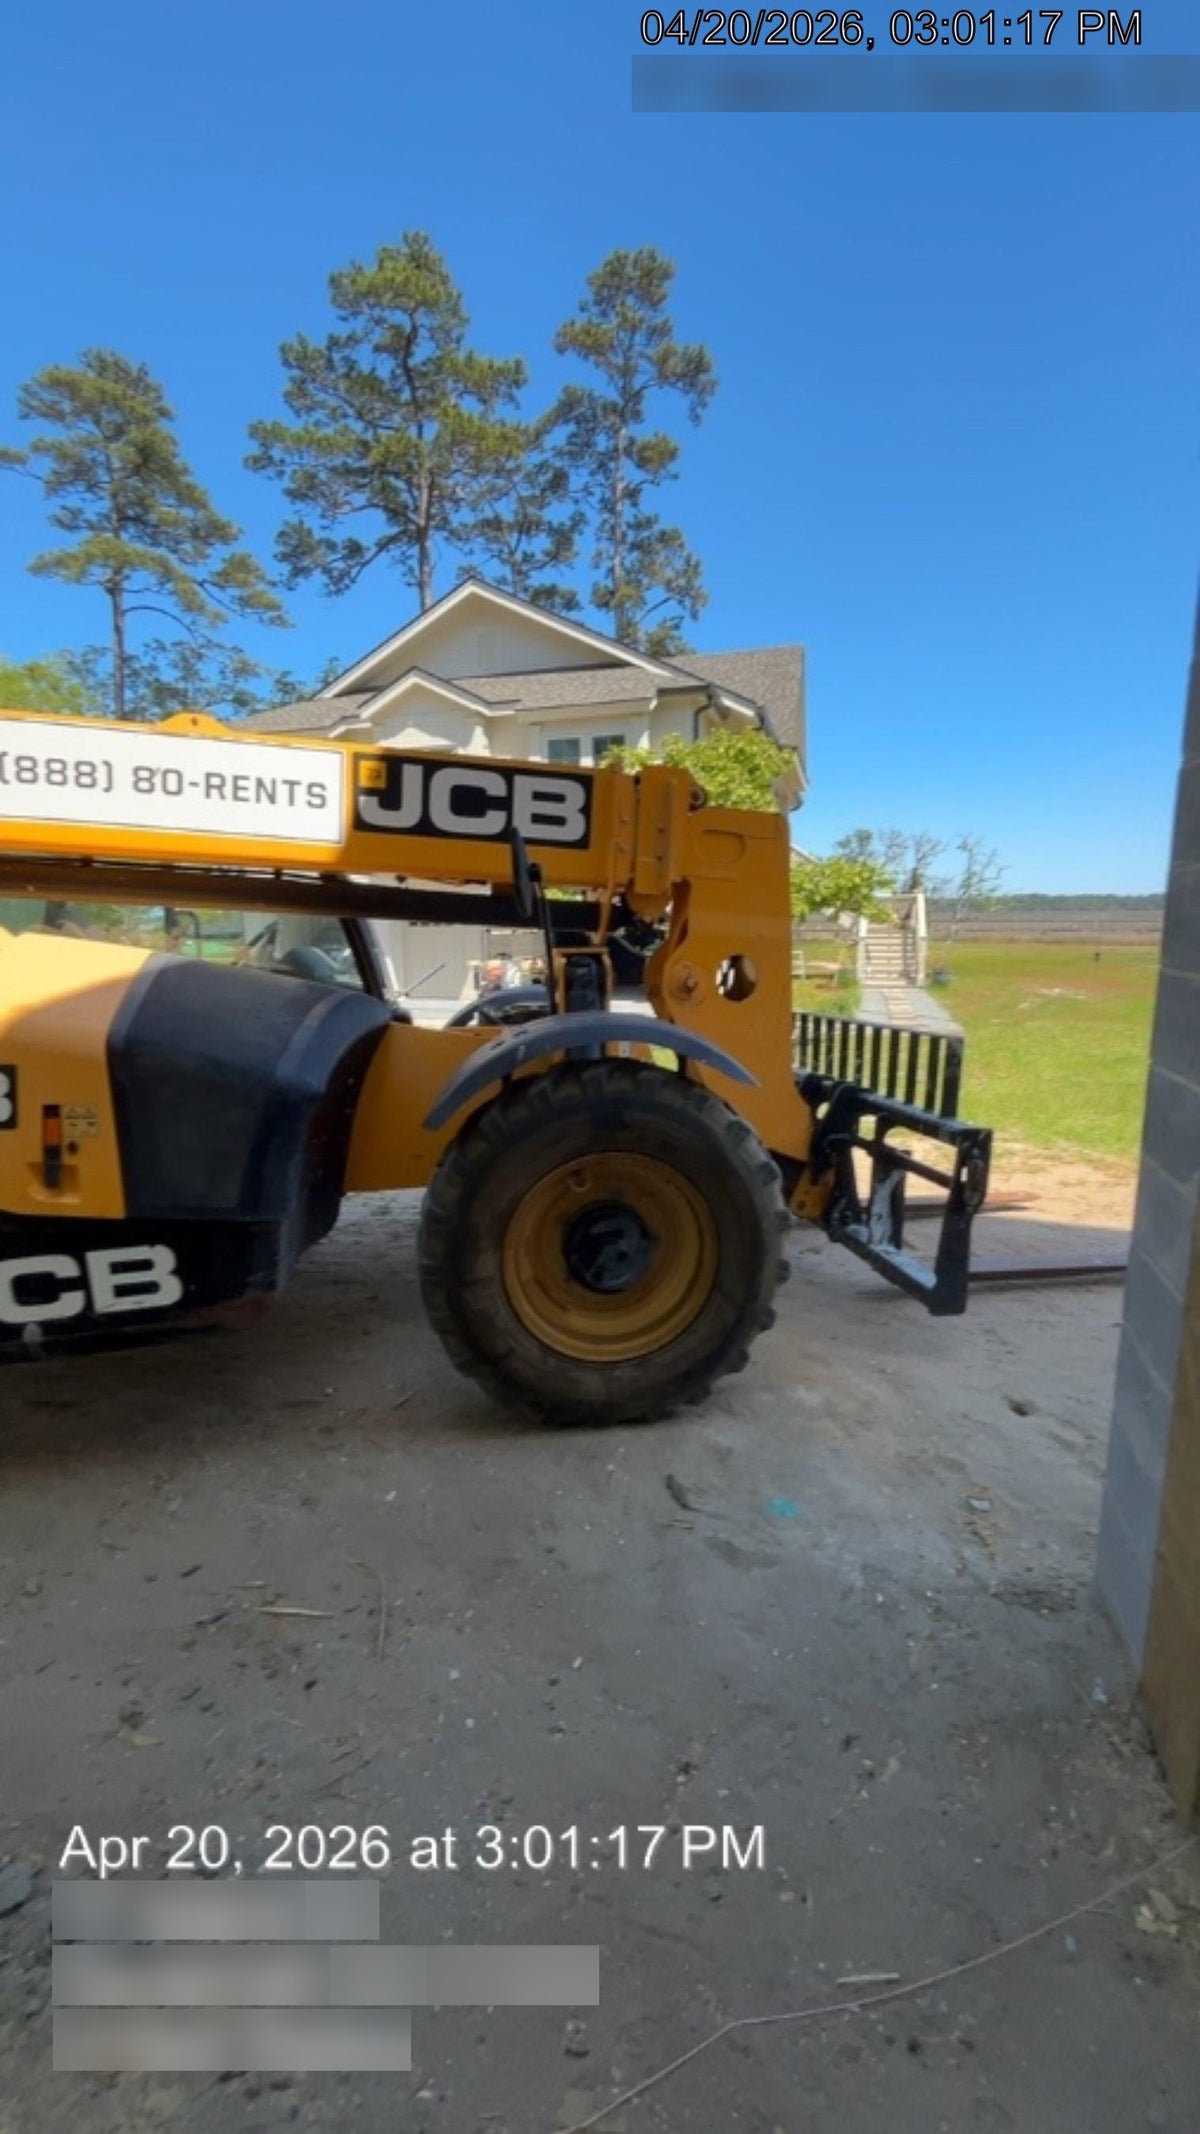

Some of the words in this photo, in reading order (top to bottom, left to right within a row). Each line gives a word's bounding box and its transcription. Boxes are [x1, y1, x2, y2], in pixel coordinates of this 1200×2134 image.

[0, 751, 113, 793] (888)
[132, 765, 327, 809] 80-RENTS
[358, 763, 586, 843] JCB
